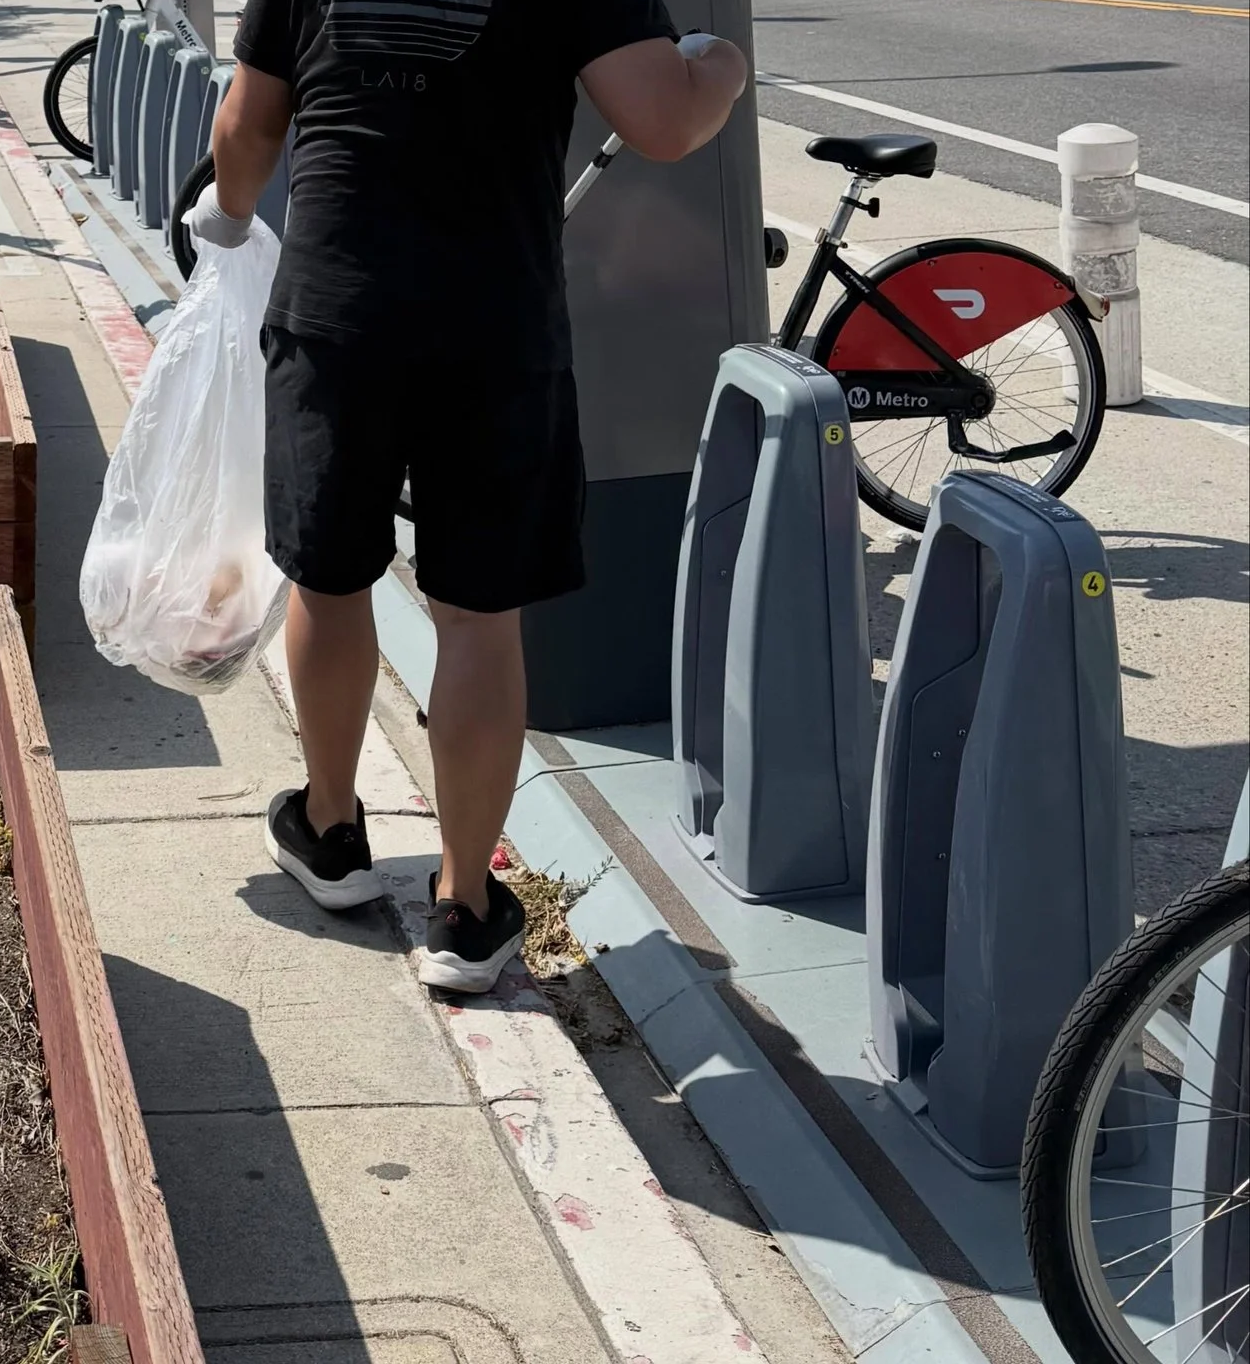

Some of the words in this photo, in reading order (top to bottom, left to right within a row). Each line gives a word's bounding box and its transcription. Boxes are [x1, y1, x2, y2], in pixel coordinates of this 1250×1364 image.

[876, 391, 929, 407] Metro
[830, 427, 839, 441] 5
[1087, 575, 1099, 592] 4
